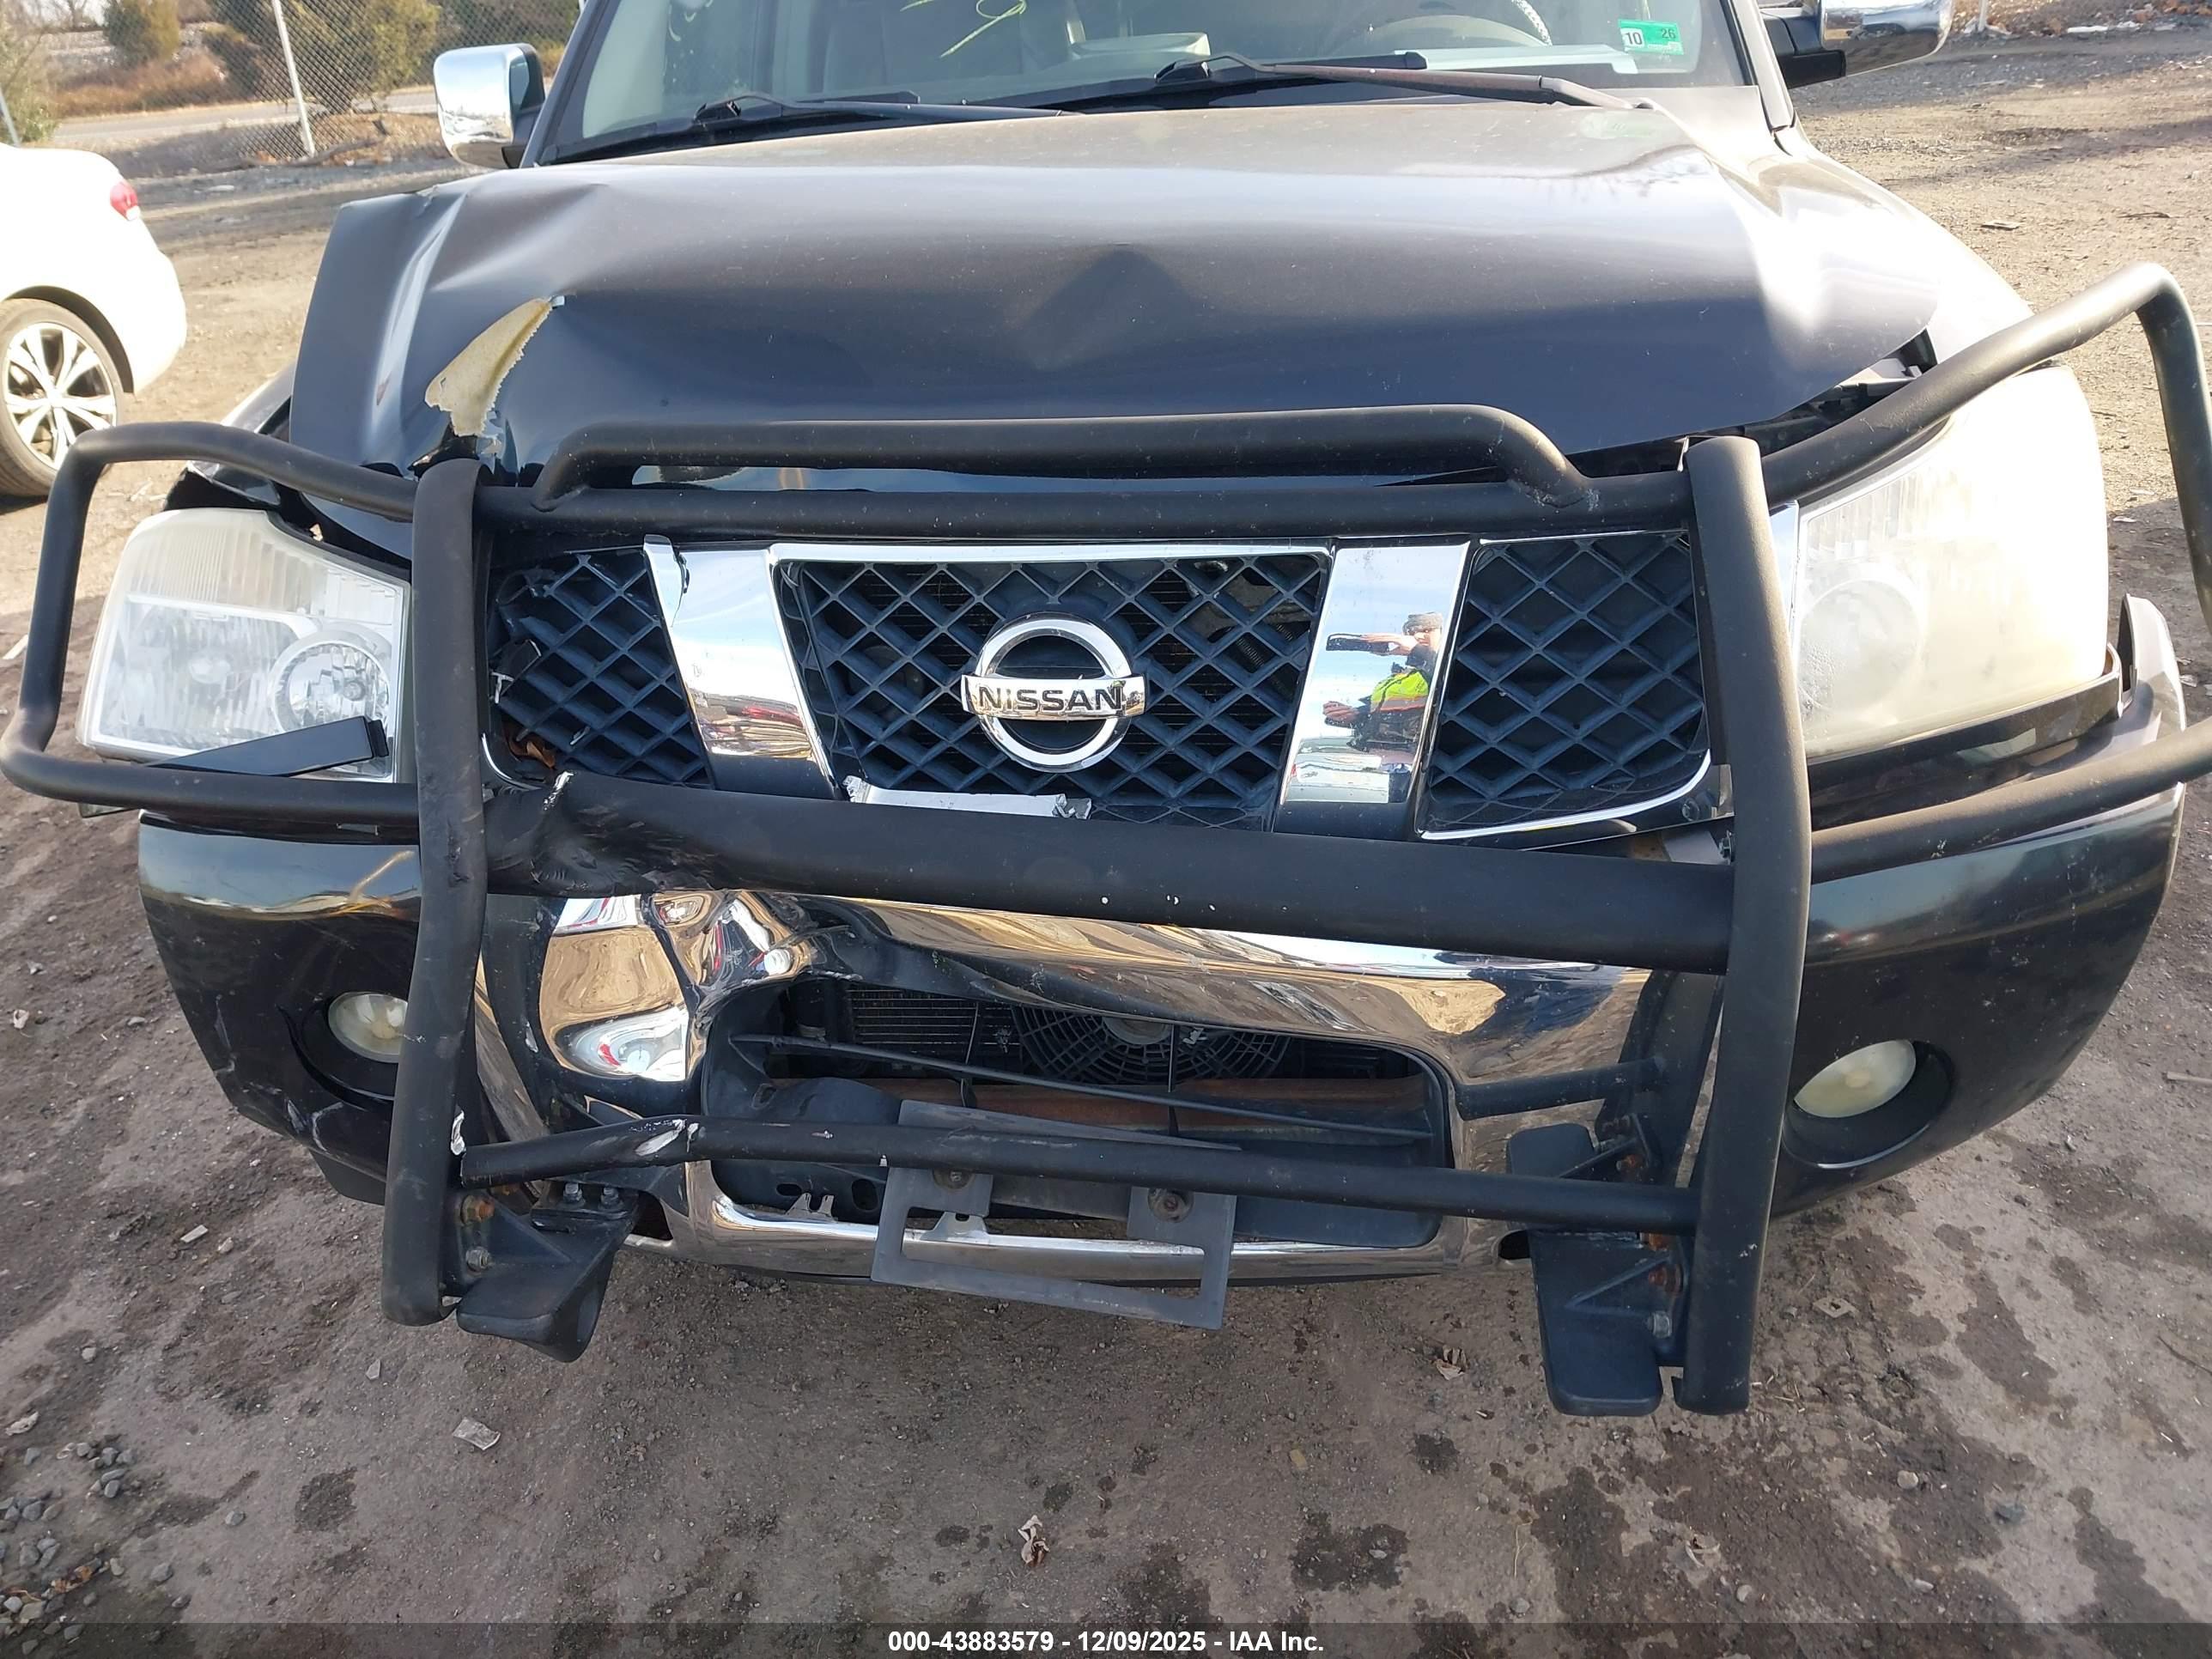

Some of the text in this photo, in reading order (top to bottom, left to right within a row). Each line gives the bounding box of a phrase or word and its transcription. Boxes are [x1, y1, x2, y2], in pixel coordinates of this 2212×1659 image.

[1625, 27, 1676, 46] 10 26
[977, 685, 1123, 712] NISSAN
